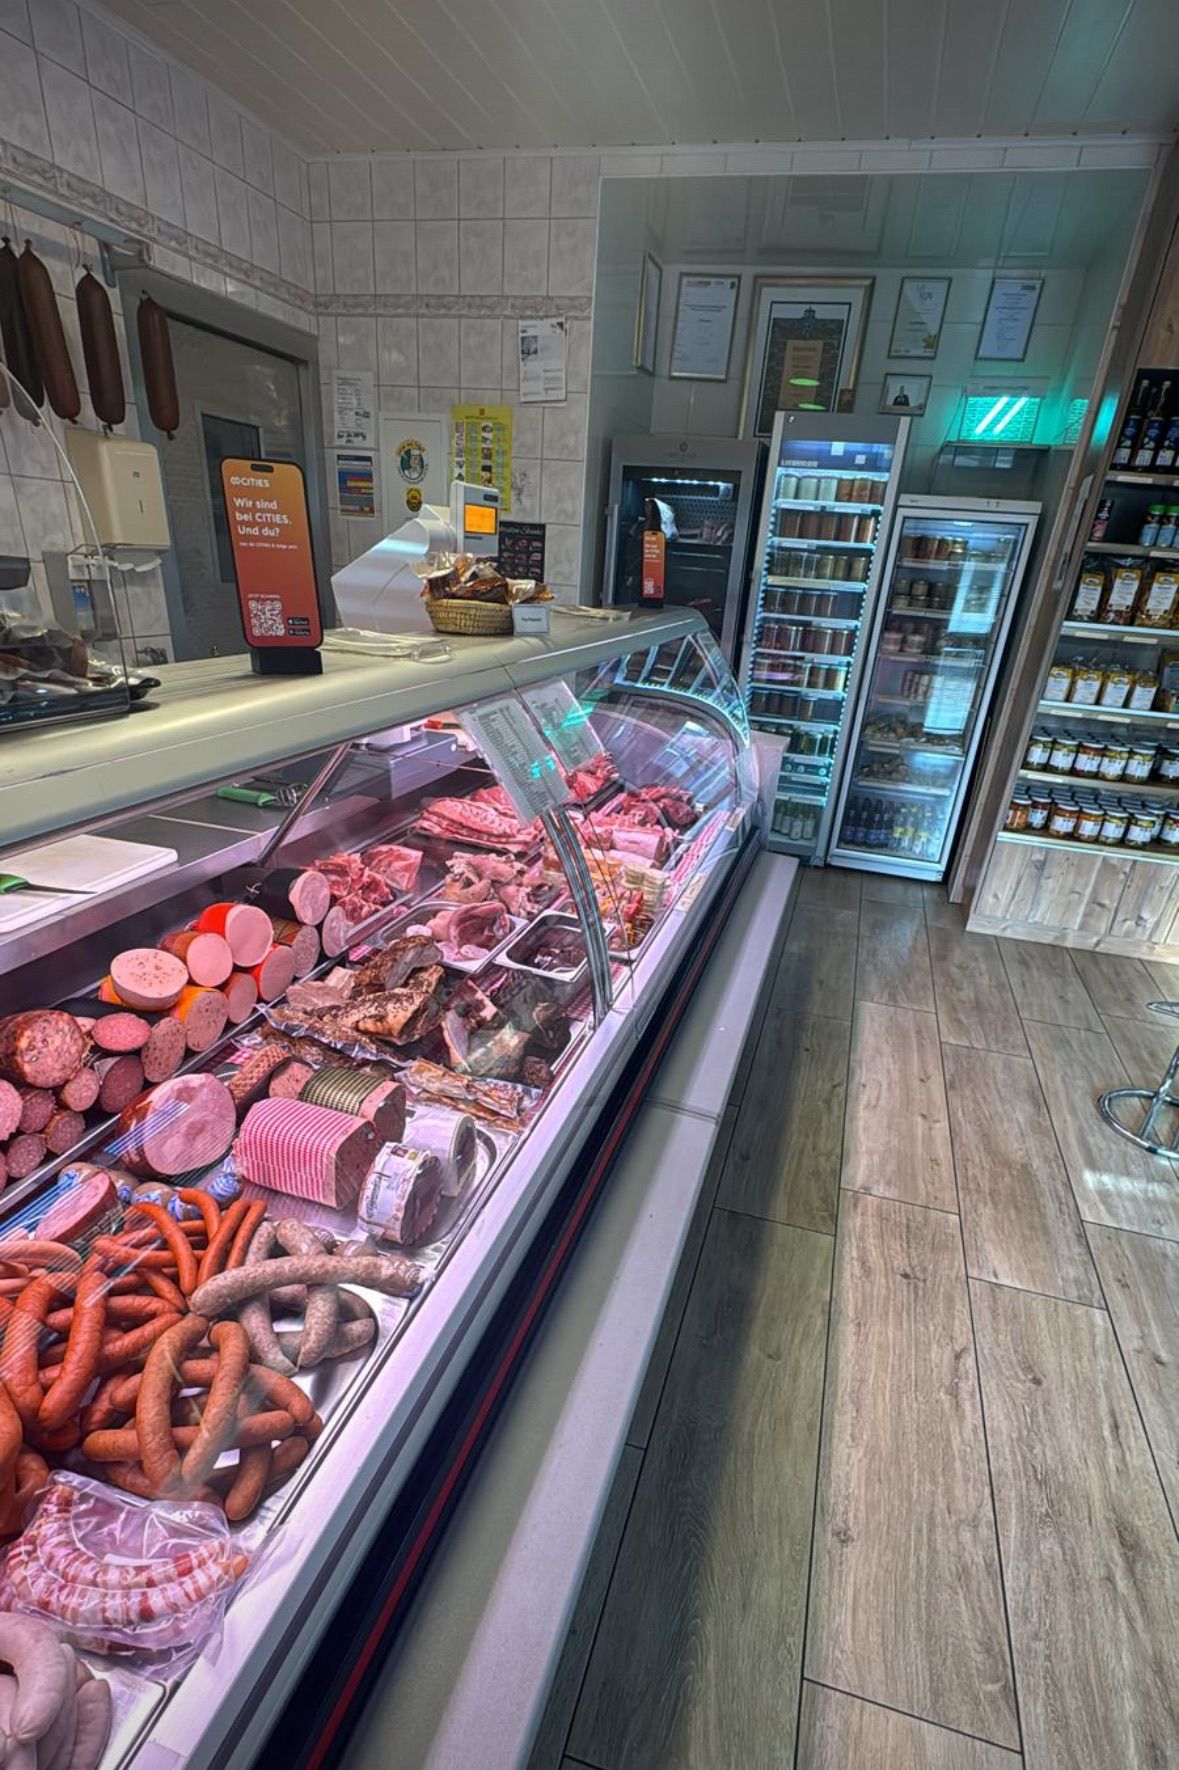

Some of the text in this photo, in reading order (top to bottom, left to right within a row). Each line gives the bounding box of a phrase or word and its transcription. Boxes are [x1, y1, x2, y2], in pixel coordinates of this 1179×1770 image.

[241, 477, 270, 488] CITIES
[233, 497, 278, 510] Wir sind
[236, 512, 292, 525] bei CITIES.
[238, 526, 280, 537] Und du?
